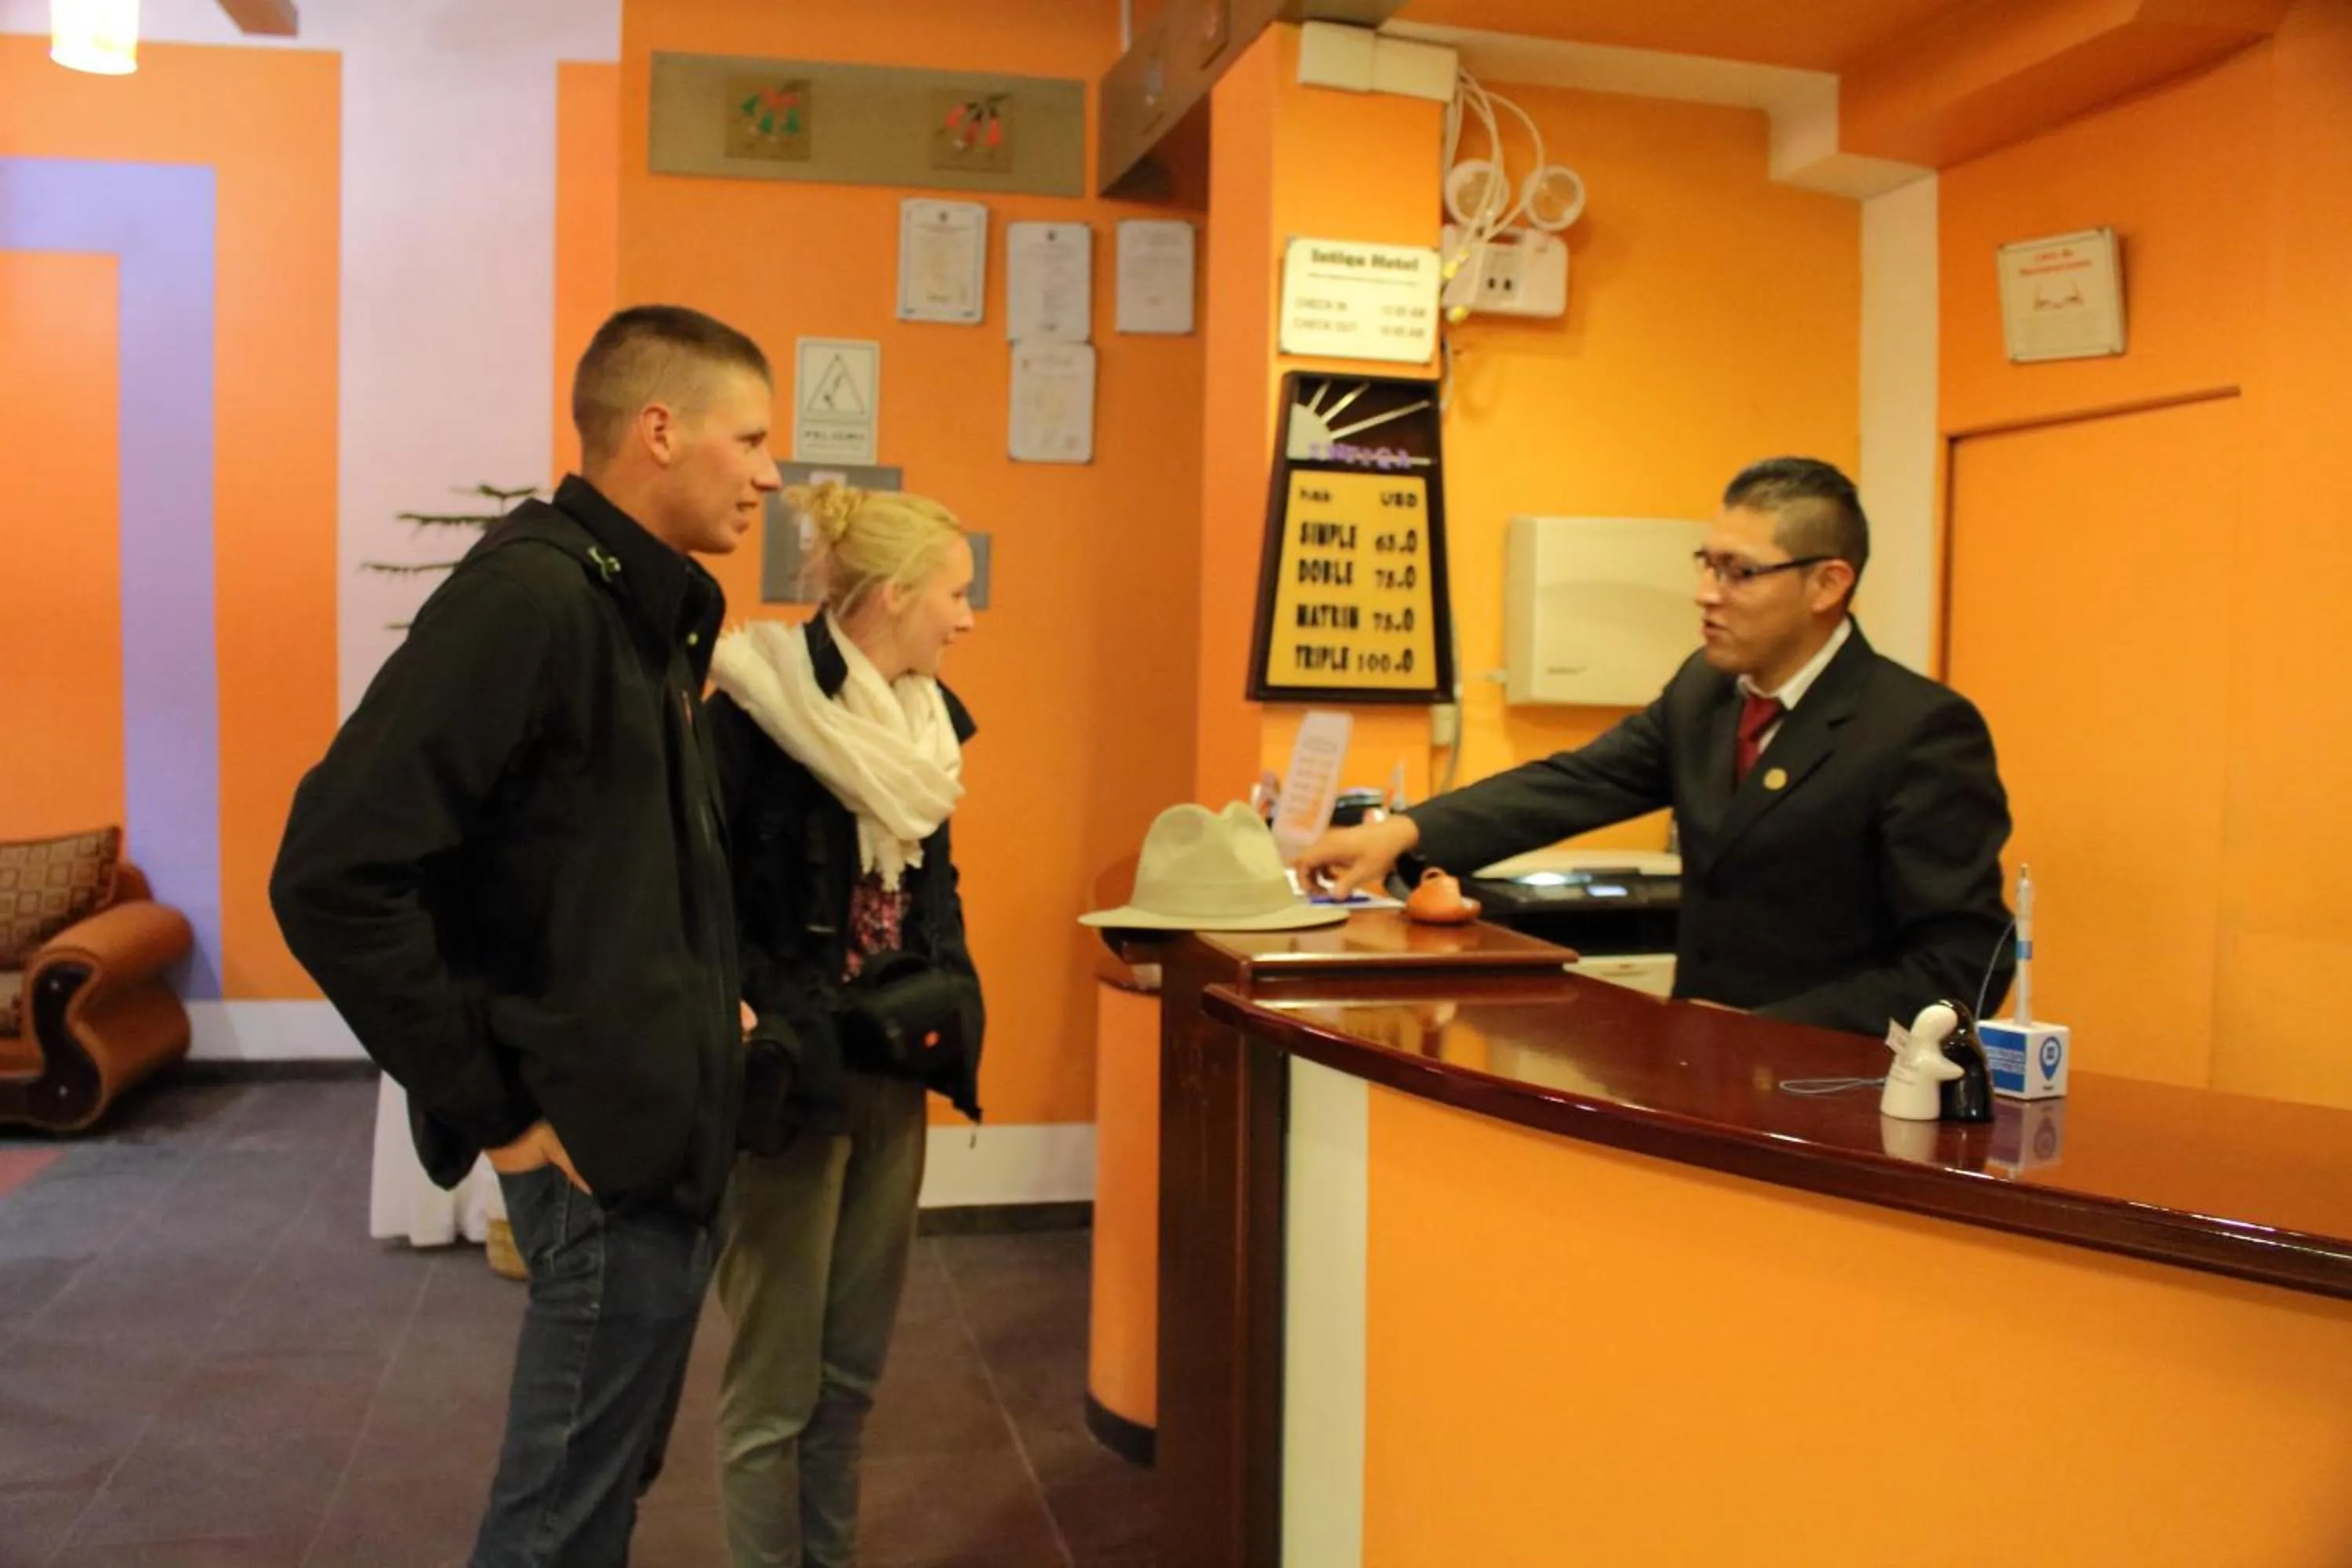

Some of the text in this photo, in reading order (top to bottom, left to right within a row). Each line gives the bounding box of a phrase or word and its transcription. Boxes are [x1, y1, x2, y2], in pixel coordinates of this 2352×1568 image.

[1371, 254, 1419, 271] Hotel
[1381, 492, 1417, 508] USD
[1300, 521, 1356, 549] SIMPLE
[1298, 559, 1352, 585] DOBLE
[1296, 644, 1349, 670] TRIPLE
